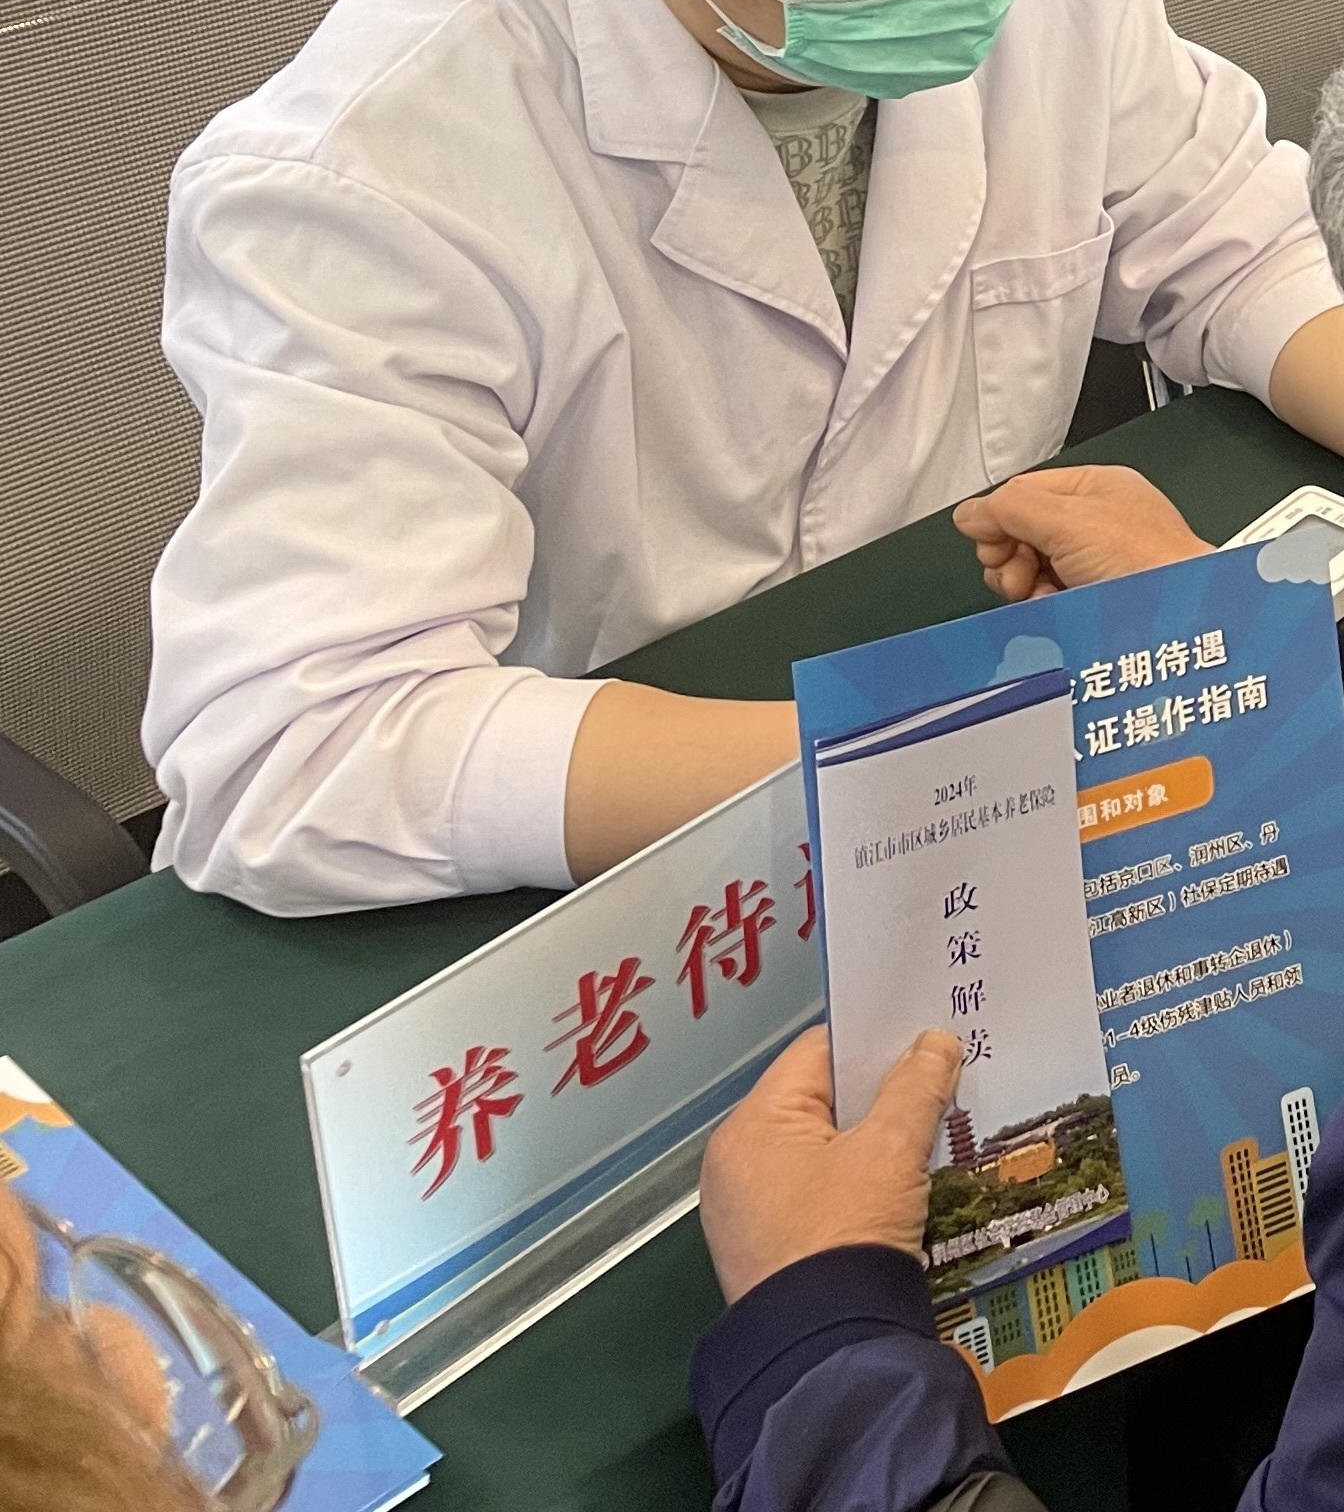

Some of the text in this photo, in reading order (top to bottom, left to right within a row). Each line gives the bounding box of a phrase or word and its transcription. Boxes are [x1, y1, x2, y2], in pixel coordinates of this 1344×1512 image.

[1070, 629, 1229, 707] 定期待遇
[1072, 674, 1269, 763] 证操作指南
[933, 774, 978, 807] 2024年
